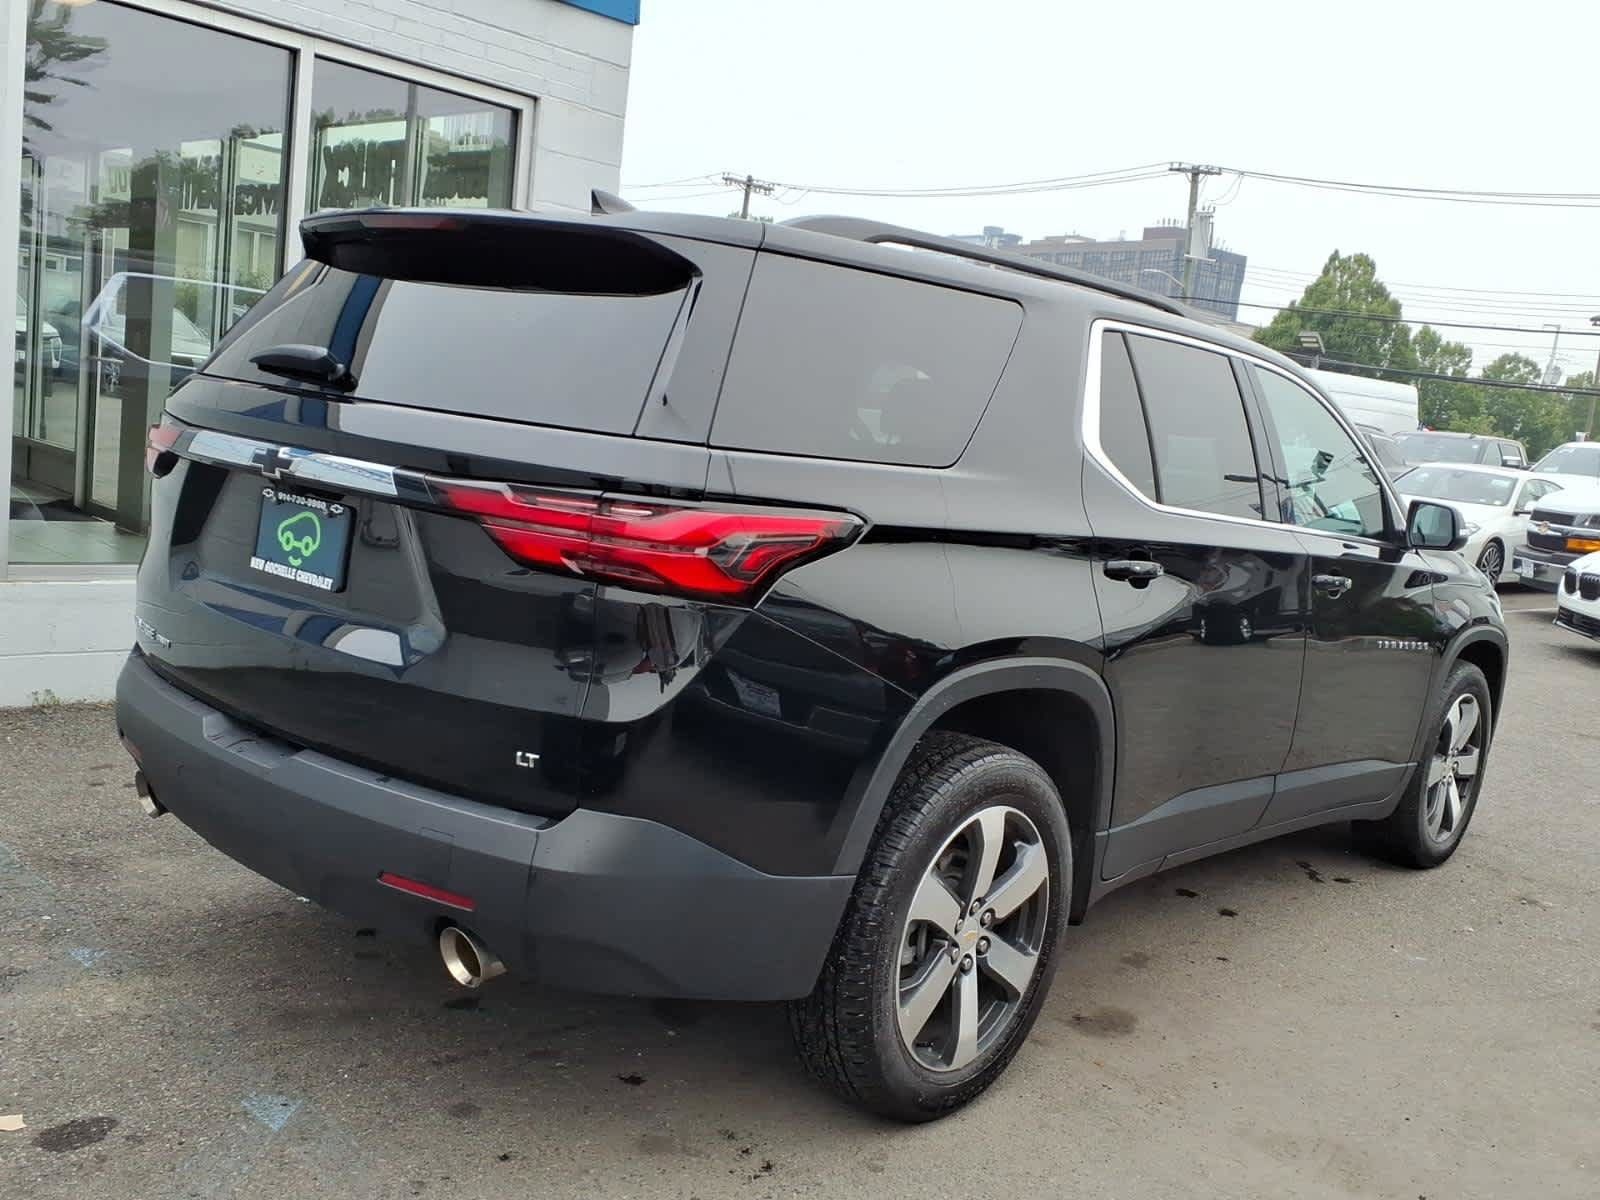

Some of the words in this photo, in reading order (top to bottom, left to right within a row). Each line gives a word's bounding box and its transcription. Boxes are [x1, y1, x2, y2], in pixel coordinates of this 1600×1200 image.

[250, 556, 265, 571] NEW
[296, 569, 334, 590] CHEVROLET
[516, 751, 540, 768] LT
